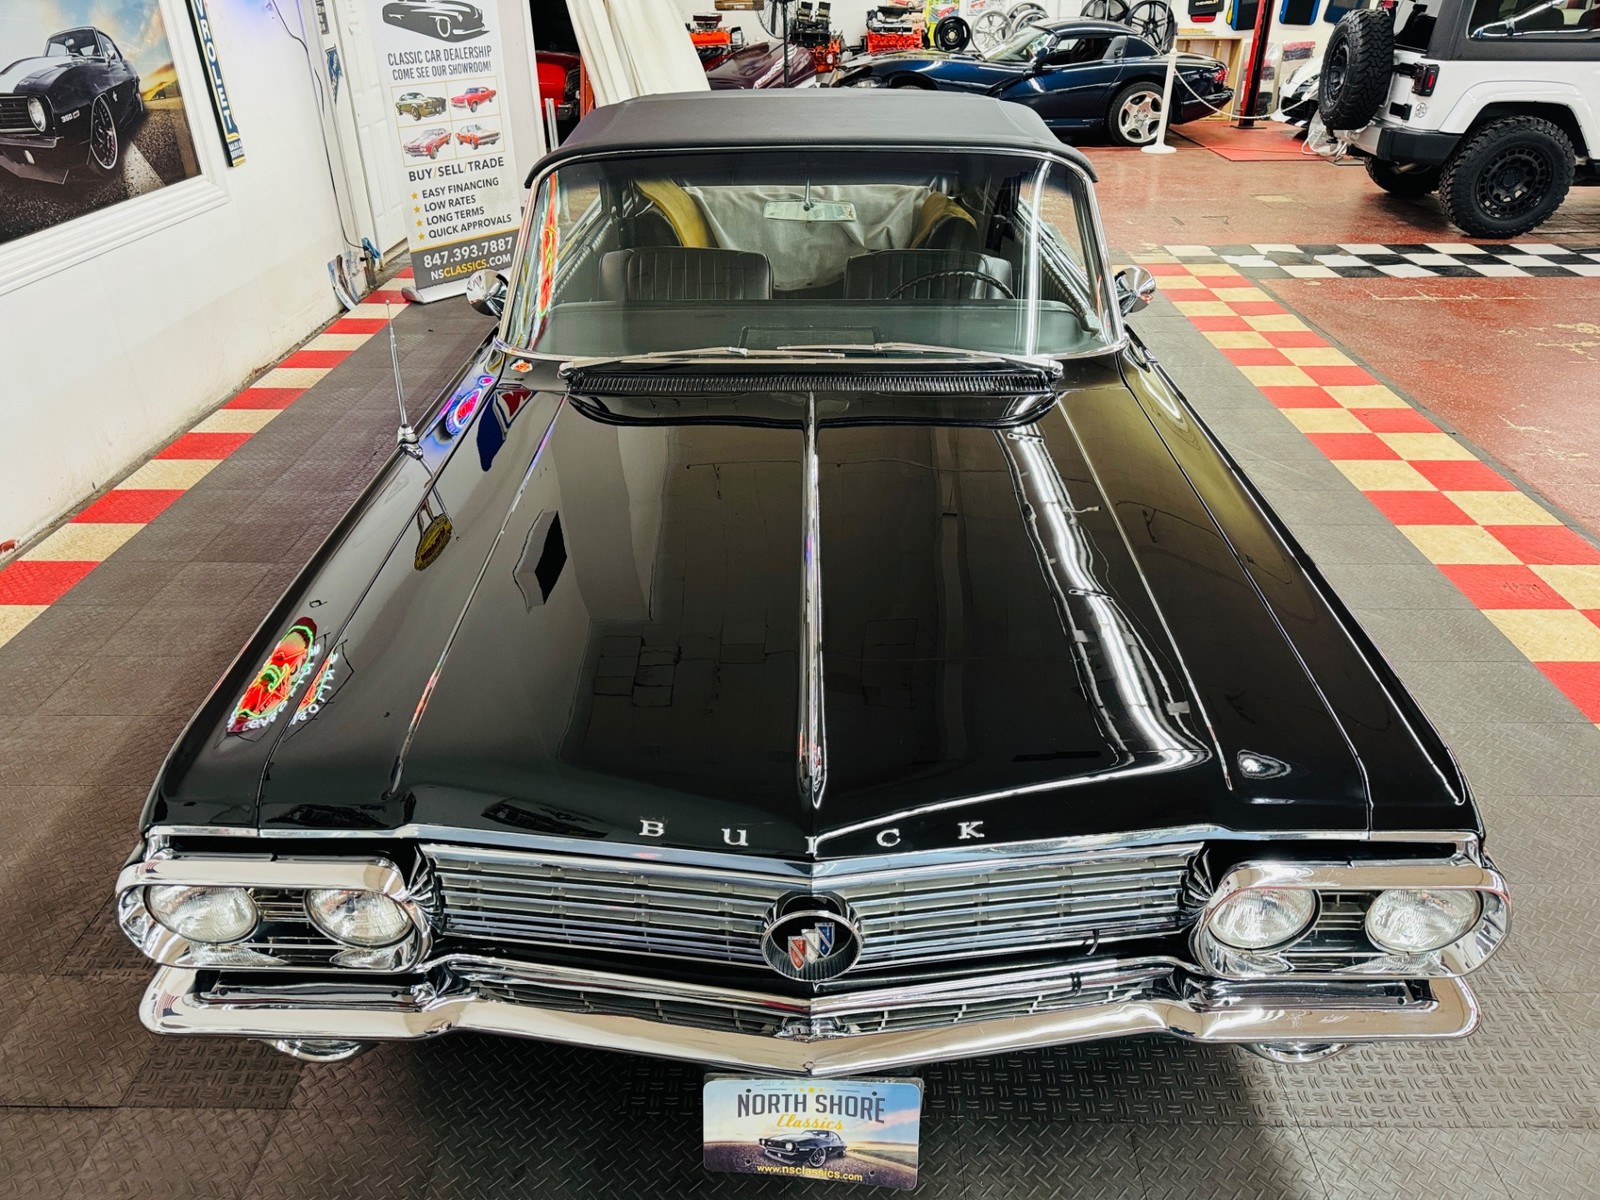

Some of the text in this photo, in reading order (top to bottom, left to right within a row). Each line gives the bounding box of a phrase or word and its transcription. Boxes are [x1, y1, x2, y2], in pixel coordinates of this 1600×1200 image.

[387, 45, 492, 66] CLASSIC CAR DEALERSHIP
[392, 60, 492, 81] COME SEE OUR SHOWROOM!
[422, 177, 499, 199] EASY FINANCING
[424, 194, 476, 212] LOW RATES
[426, 206, 485, 226] LONG TERMS
[428, 214, 512, 239] QUICK APPROVALS
[423, 237, 513, 268] 847.393.7887
[430, 253, 511, 280] NSCLASSICS.COM
[638, 818, 985, 855] BUICK
[737, 1093, 886, 1124] NORTH SHORE
[776, 1113, 845, 1131] Classics
[756, 1164, 863, 1182] www.nsclassics.com
